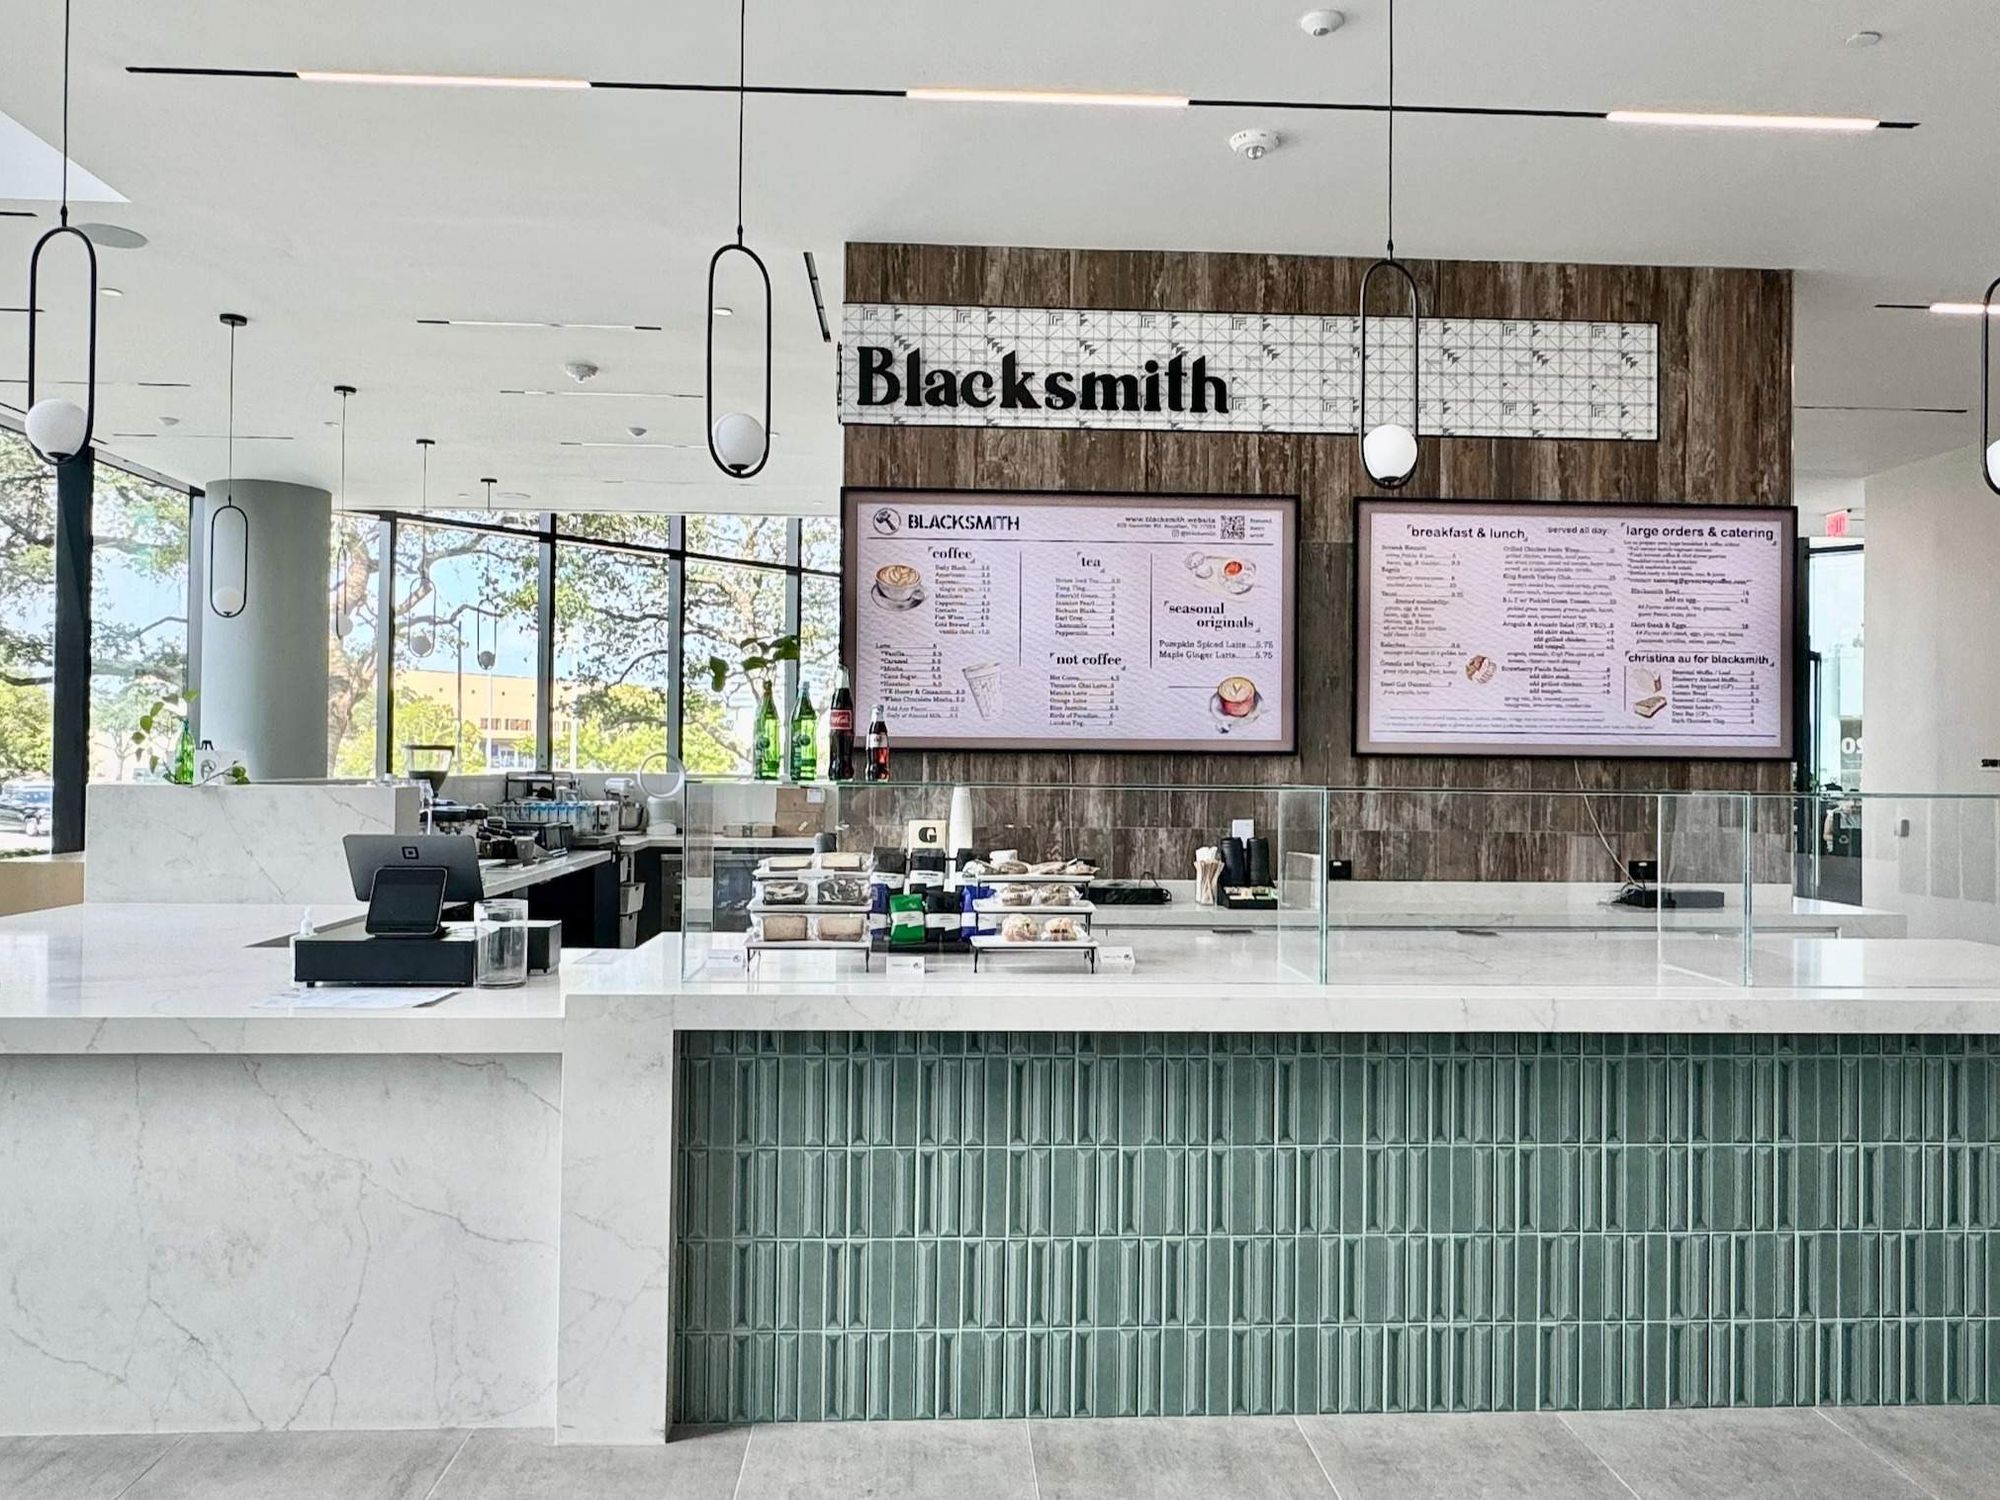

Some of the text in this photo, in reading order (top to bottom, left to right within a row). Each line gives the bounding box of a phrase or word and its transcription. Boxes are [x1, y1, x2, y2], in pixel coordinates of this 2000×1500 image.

[857, 346, 1230, 414] Blacksmith
[908, 513, 1020, 531] BLACKSMITH
[1411, 526, 1525, 539] breakfast & lunch
[1626, 525, 1774, 541] large orders & catering
[932, 547, 973, 559] coffee
[1081, 557, 1101, 567] tea
[1169, 602, 1225, 614] seasonal
[1196, 616, 1255, 631] originals
[1158, 640, 1195, 649] Pumpkin
[1196, 640, 1224, 649] Spiced
[1056, 652, 1122, 665] not coffee
[1158, 651, 1184, 659] Maple
[1185, 651, 1213, 660] Ginger
[1628, 653, 1769, 664] christina au for blacksmith
[918, 826, 938, 843] G
